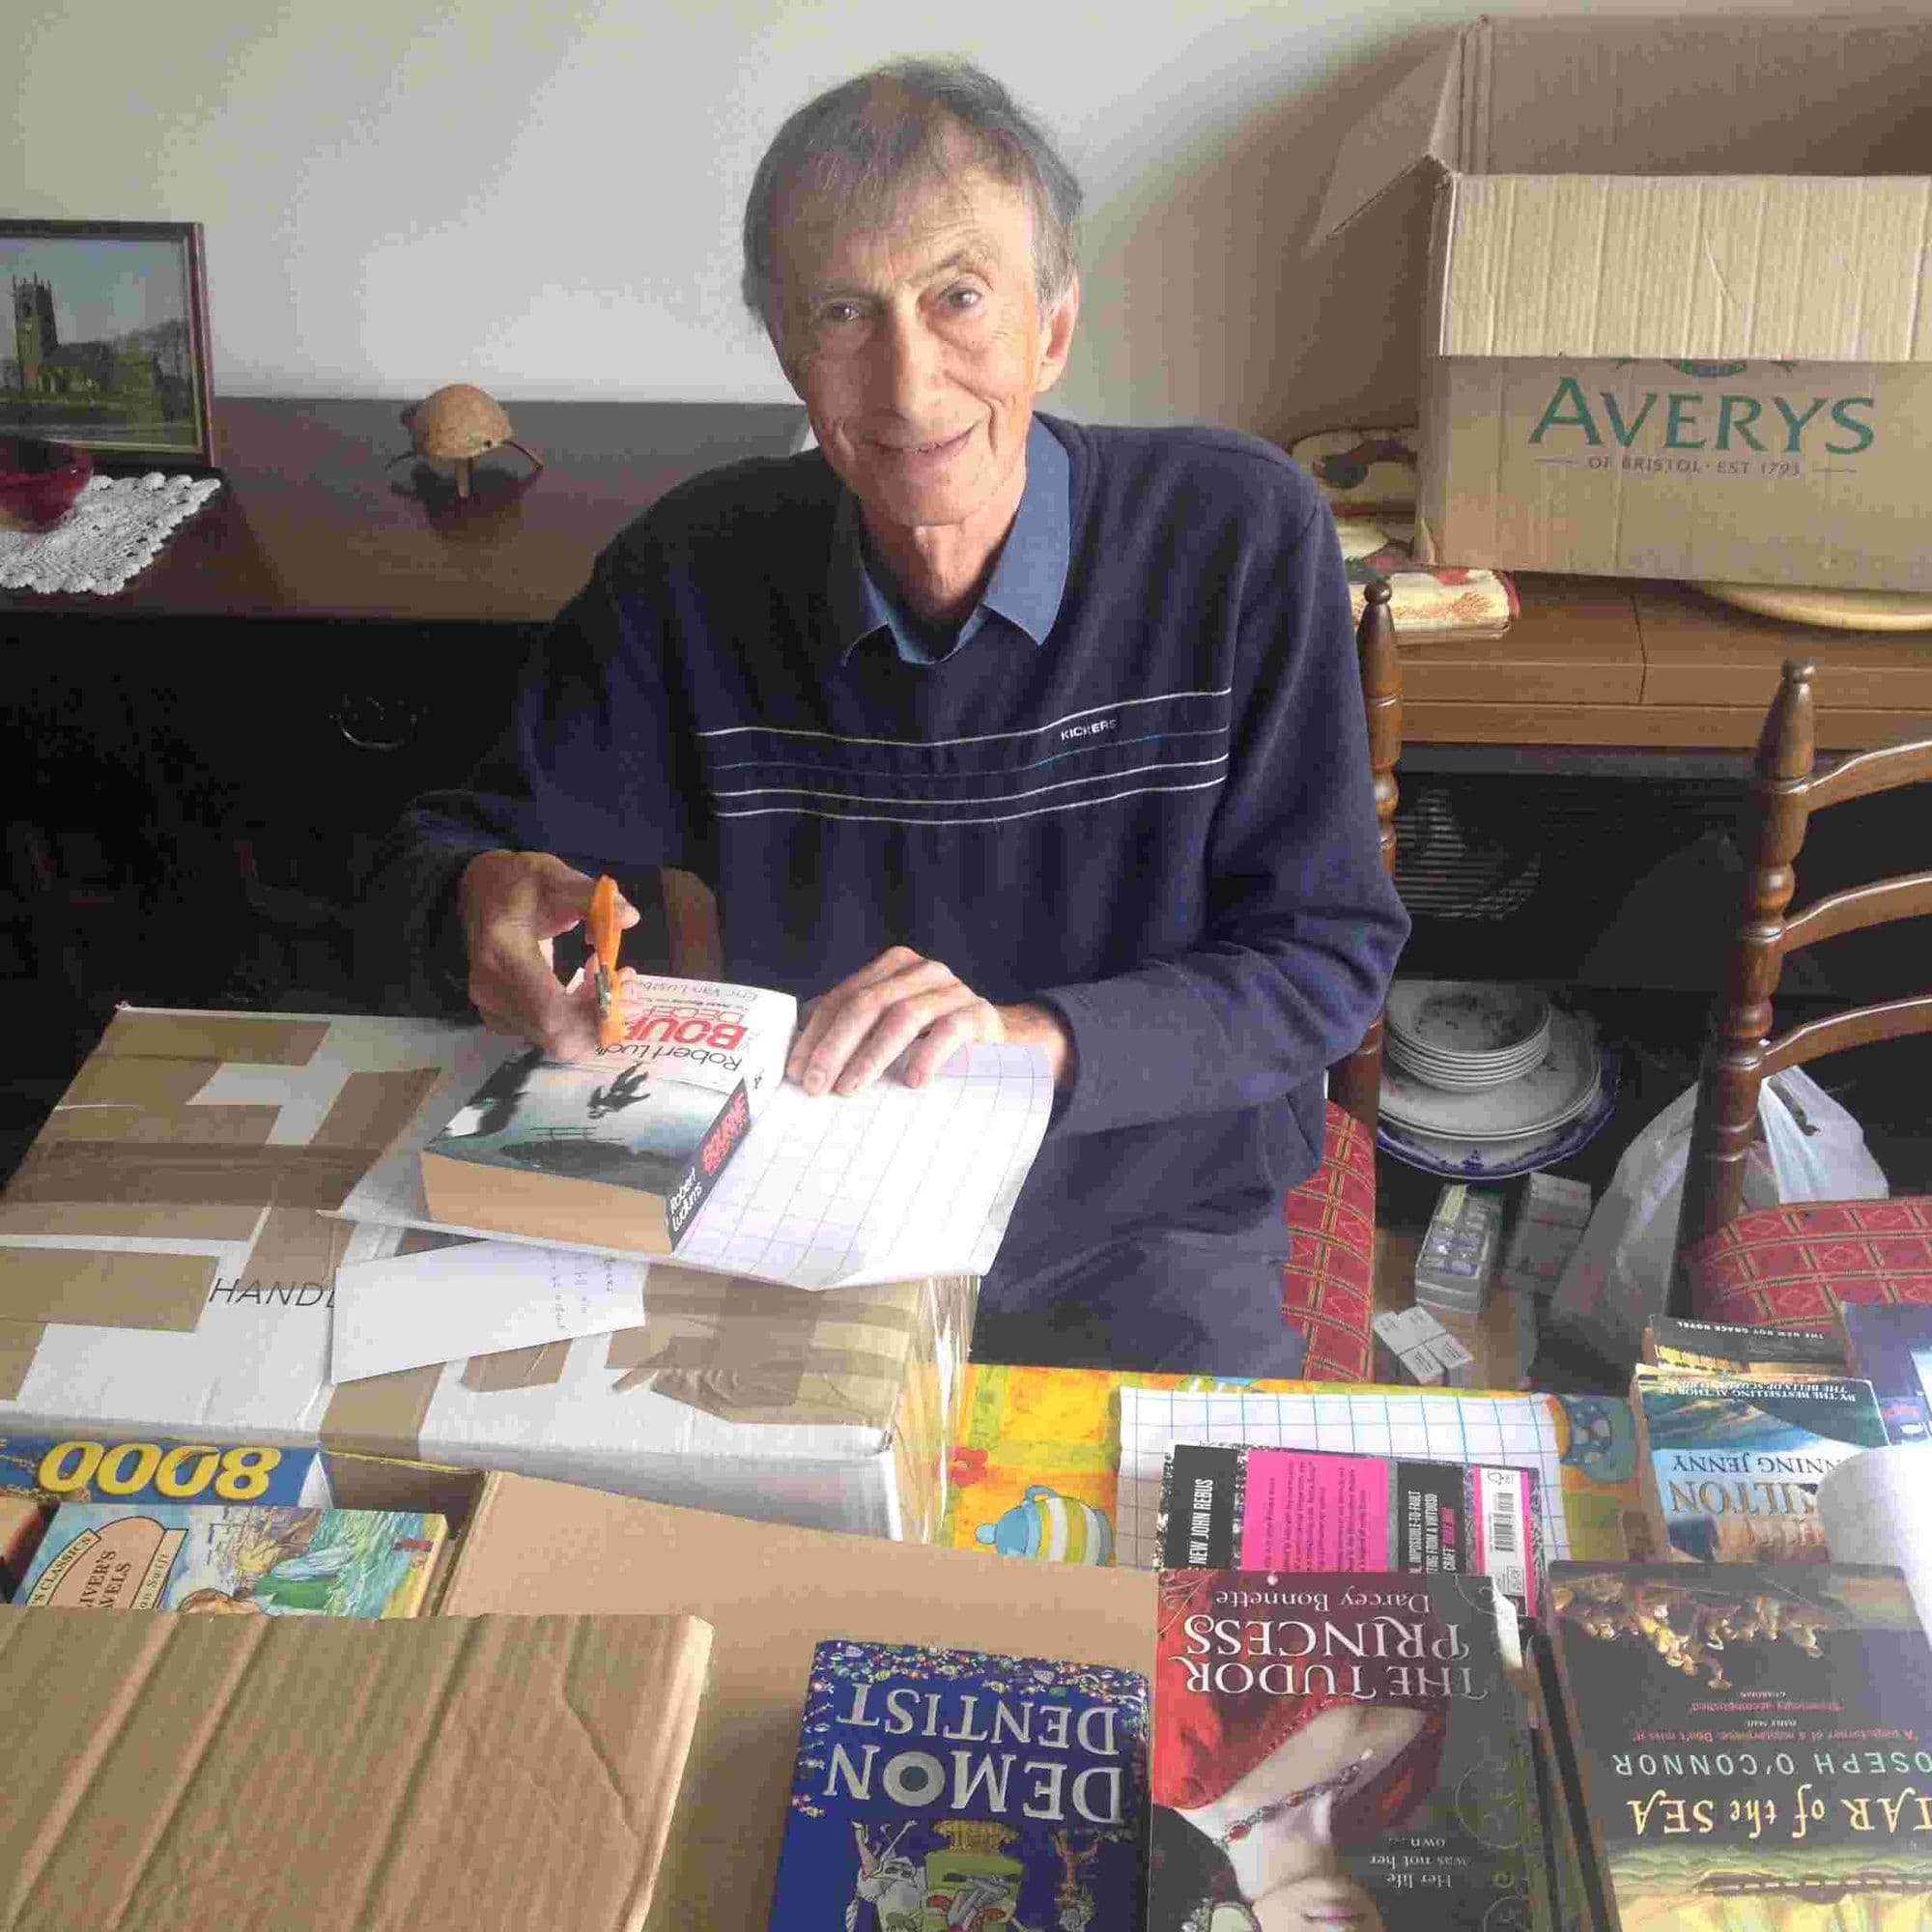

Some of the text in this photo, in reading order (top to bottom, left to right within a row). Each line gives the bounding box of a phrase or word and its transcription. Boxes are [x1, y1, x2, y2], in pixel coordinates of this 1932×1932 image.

[1528, 377, 1874, 455] AVERYS
[1622, 455, 1700, 473] BRISTOL
[1717, 459, 1749, 474] EST
[1061, 720, 1117, 741] KICKERS
[652, 1046, 743, 1072] Robert
[669, 1166, 696, 1214] Robert
[1676, 1321, 1711, 1330] NOVEL
[1713, 1324, 1748, 1333] GRACE
[1776, 1329, 1800, 1338] NEW
[1804, 1331, 1825, 1340] THE
[1676, 1387, 1729, 1397] AUTHOR
[1729, 1388, 1809, 1399] BESTSELLING
[1811, 1391, 1837, 1401] THE
[1823, 1383, 1847, 1393] THE
[1837, 1392, 1856, 1402] BY
[38, 1440, 283, 1501] 8000
[1672, 1452, 1752, 1473] JENNY
[1188, 1478, 1214, 1565] NEW JOHN REBUS
[41, 1535, 92, 1591] CLASSICS
[78, 1549, 116, 1608] IVER'S
[99, 1561, 132, 1608] VELS
[1215, 1586, 1431, 1614] Darcey Bonnette
[1184, 1614, 1469, 1660] PRINCESS
[1168, 1655, 1489, 1701] THE TUDOR
[836, 1682, 1121, 1756] DENTIST
[1678, 1730, 1713, 1743] Don't
[1611, 1752, 1795, 1776] O'CONNOR
[822, 1743, 1123, 1825] DEMON
[1625, 1789, 1715, 1836] SEA
[1729, 1799, 1776, 1838] the
[1791, 1783, 1826, 1838] of
[1369, 1854, 1467, 1869] was not her
[1385, 1873, 1453, 1888] Her life
